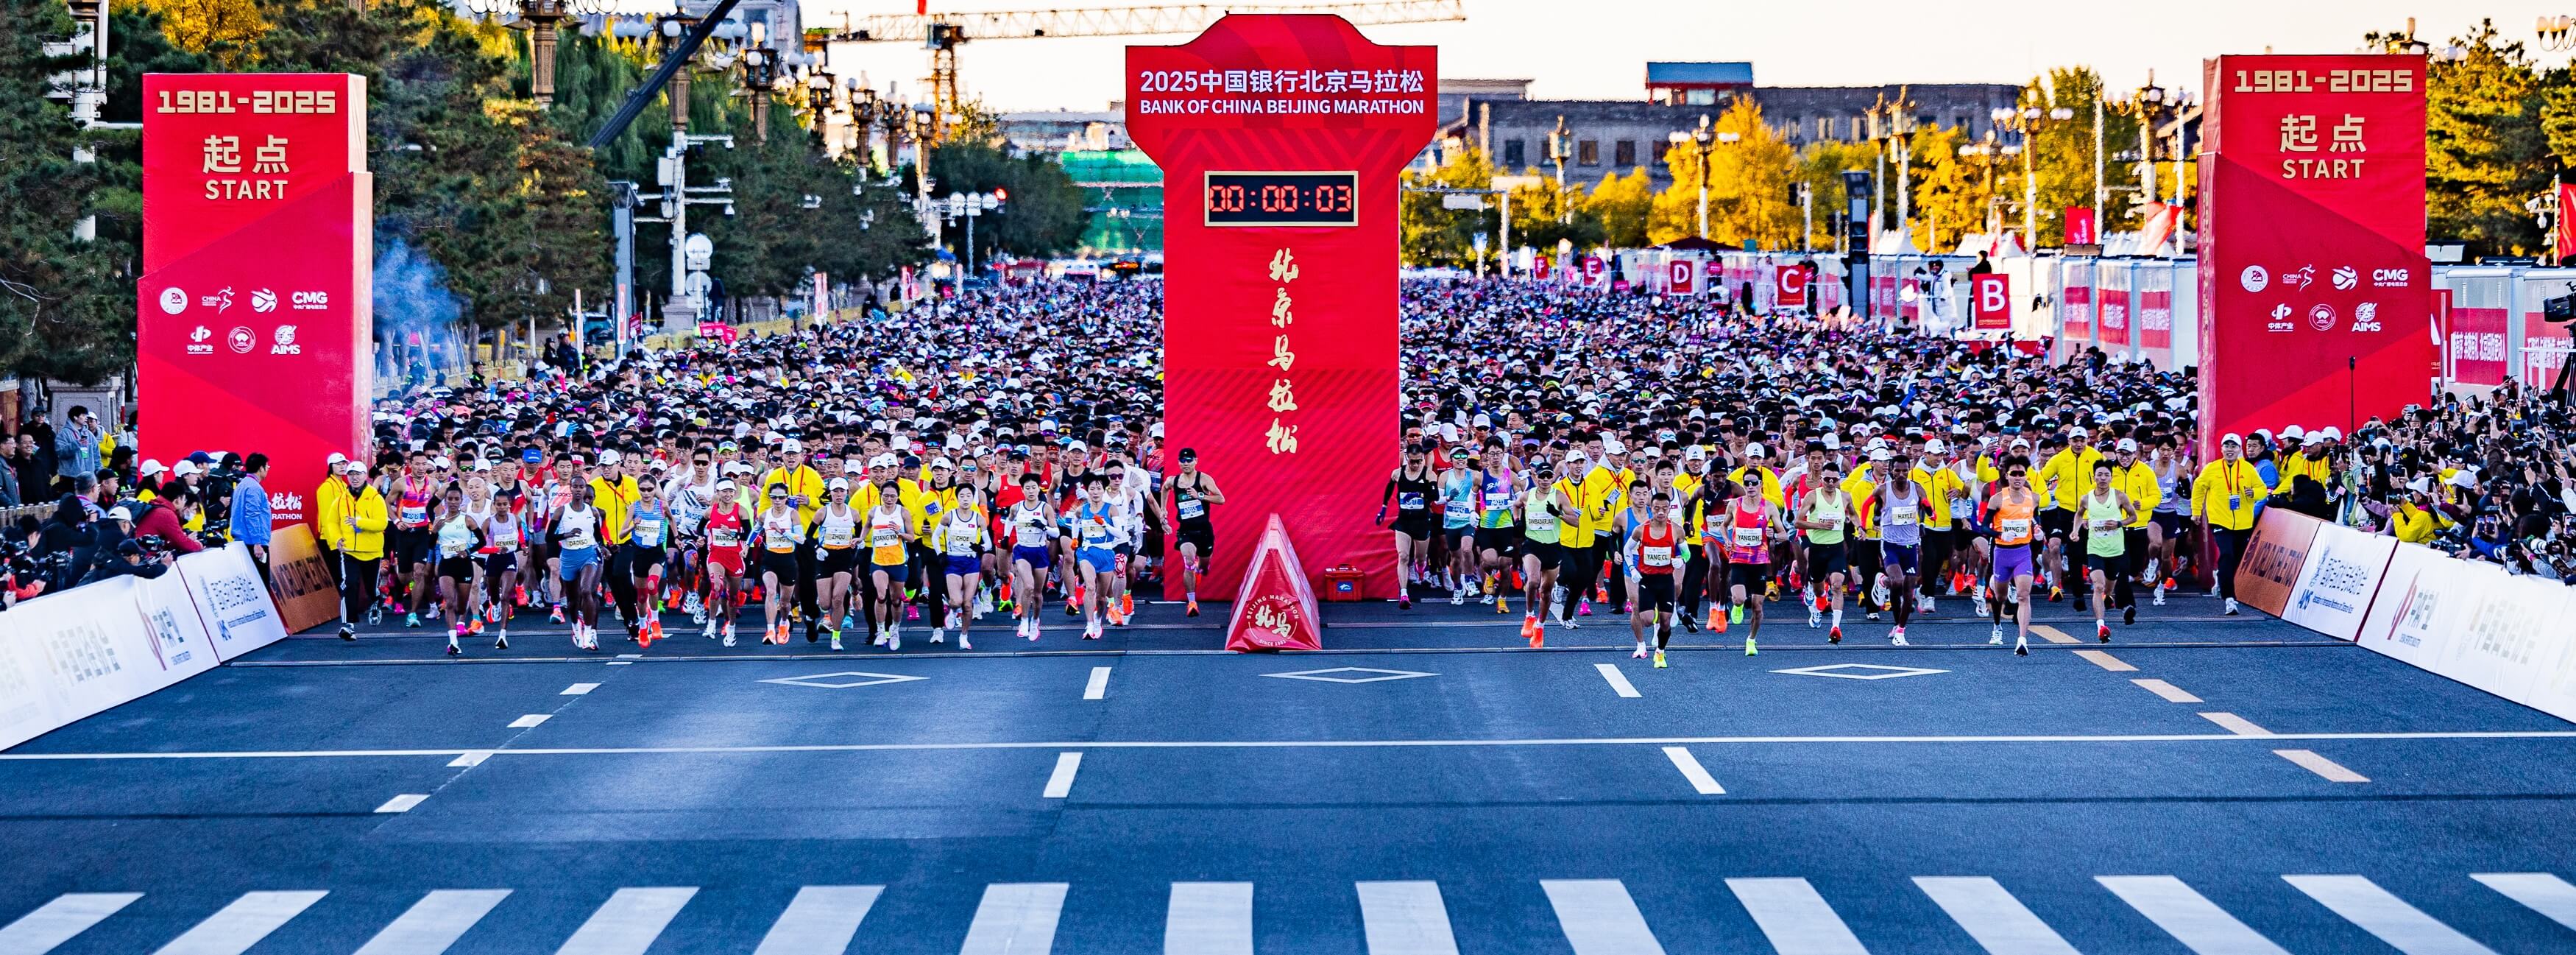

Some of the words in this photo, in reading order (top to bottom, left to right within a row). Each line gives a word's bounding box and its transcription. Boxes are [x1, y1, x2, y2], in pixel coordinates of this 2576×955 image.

[1140, 69, 1424, 94] 2025中国银行北京马拉松
[2234, 69, 2413, 93] 1981-2025
[157, 91, 336, 113] 1981-2025
[1140, 99, 1185, 114] BANK
[1187, 99, 1209, 114] OF
[1211, 99, 1263, 114] CHINA
[1267, 99, 1331, 114] BEIJING
[1334, 99, 1424, 114] MARATHON
[2280, 113, 2366, 152] 起点
[202, 135, 289, 173] 起点
[2282, 159, 2365, 178] START
[205, 180, 288, 200] START
[1209, 185, 1352, 212] 00:00:03
[1674, 264, 1688, 283] D
[1783, 269, 1800, 293] C
[2373, 269, 2408, 281] CMG
[292, 292, 328, 303] CMG
[1982, 280, 2005, 311] B
[2352, 322, 2381, 331] AIMS
[271, 344, 300, 354] AIMS
[1265, 247, 1300, 455] 北京马拉松
[265, 492, 302, 510] 拉松
[1246, 596, 1267, 619] BEIJING
[1270, 594, 1300, 619] MARATHON
[1255, 604, 1292, 638] 北马
